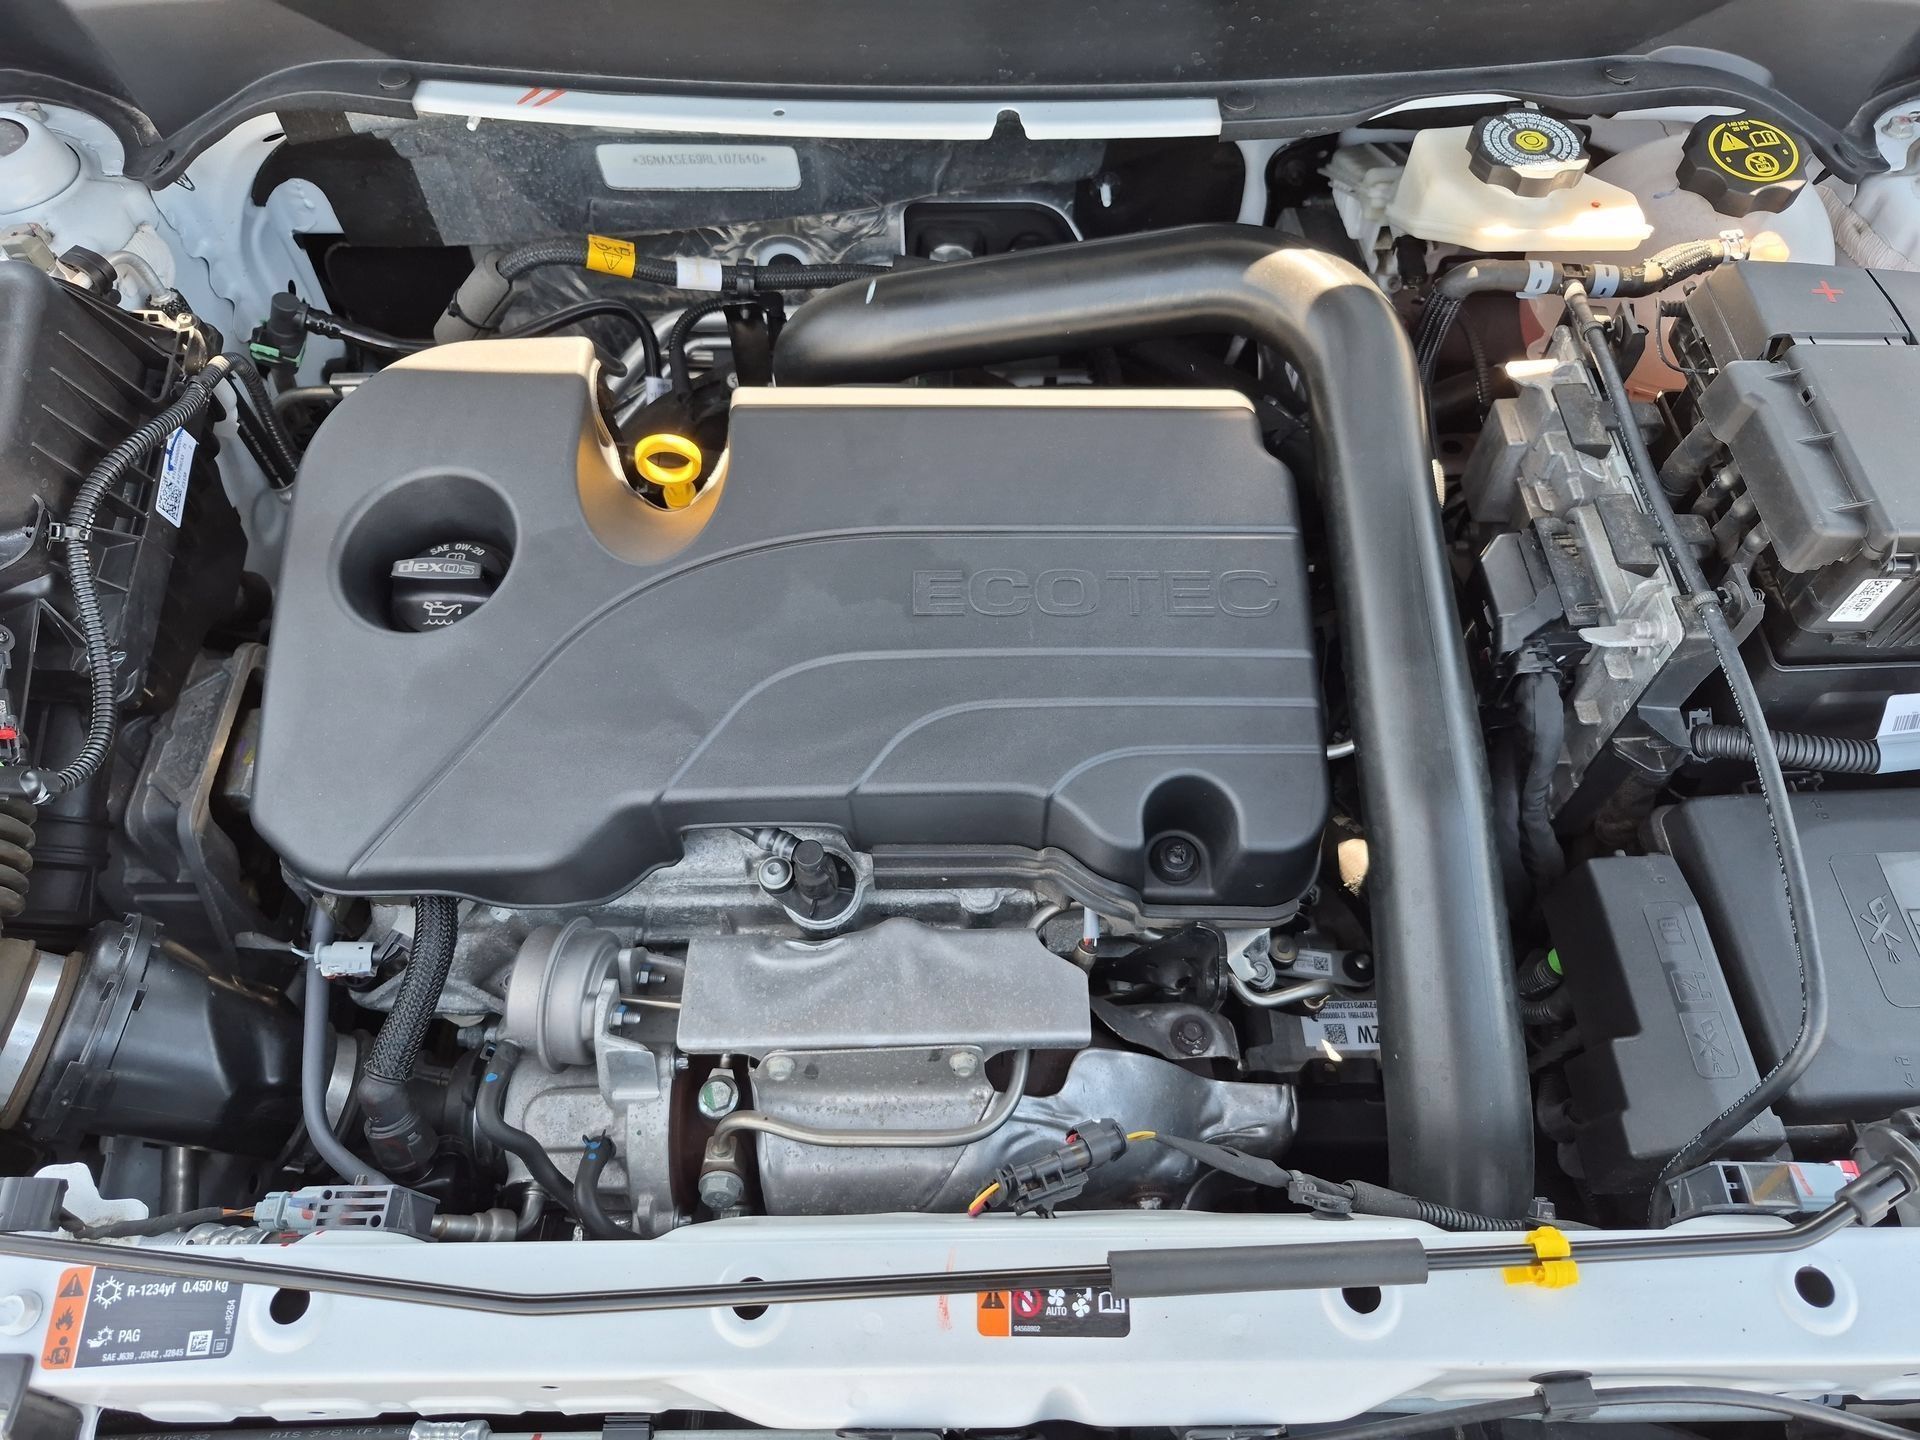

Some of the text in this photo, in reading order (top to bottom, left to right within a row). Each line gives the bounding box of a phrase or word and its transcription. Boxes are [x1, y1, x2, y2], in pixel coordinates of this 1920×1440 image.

[430, 543, 486, 556] SAE 0W-20
[398, 561, 475, 575] dexos
[913, 569, 1279, 617] ECOTEC
[127, 1281, 229, 1297] R-1234yf 0.450 kg
[1045, 1306, 1067, 1316] AUTO
[118, 1329, 141, 1343] PAG
[102, 1352, 116, 1362] SAE
